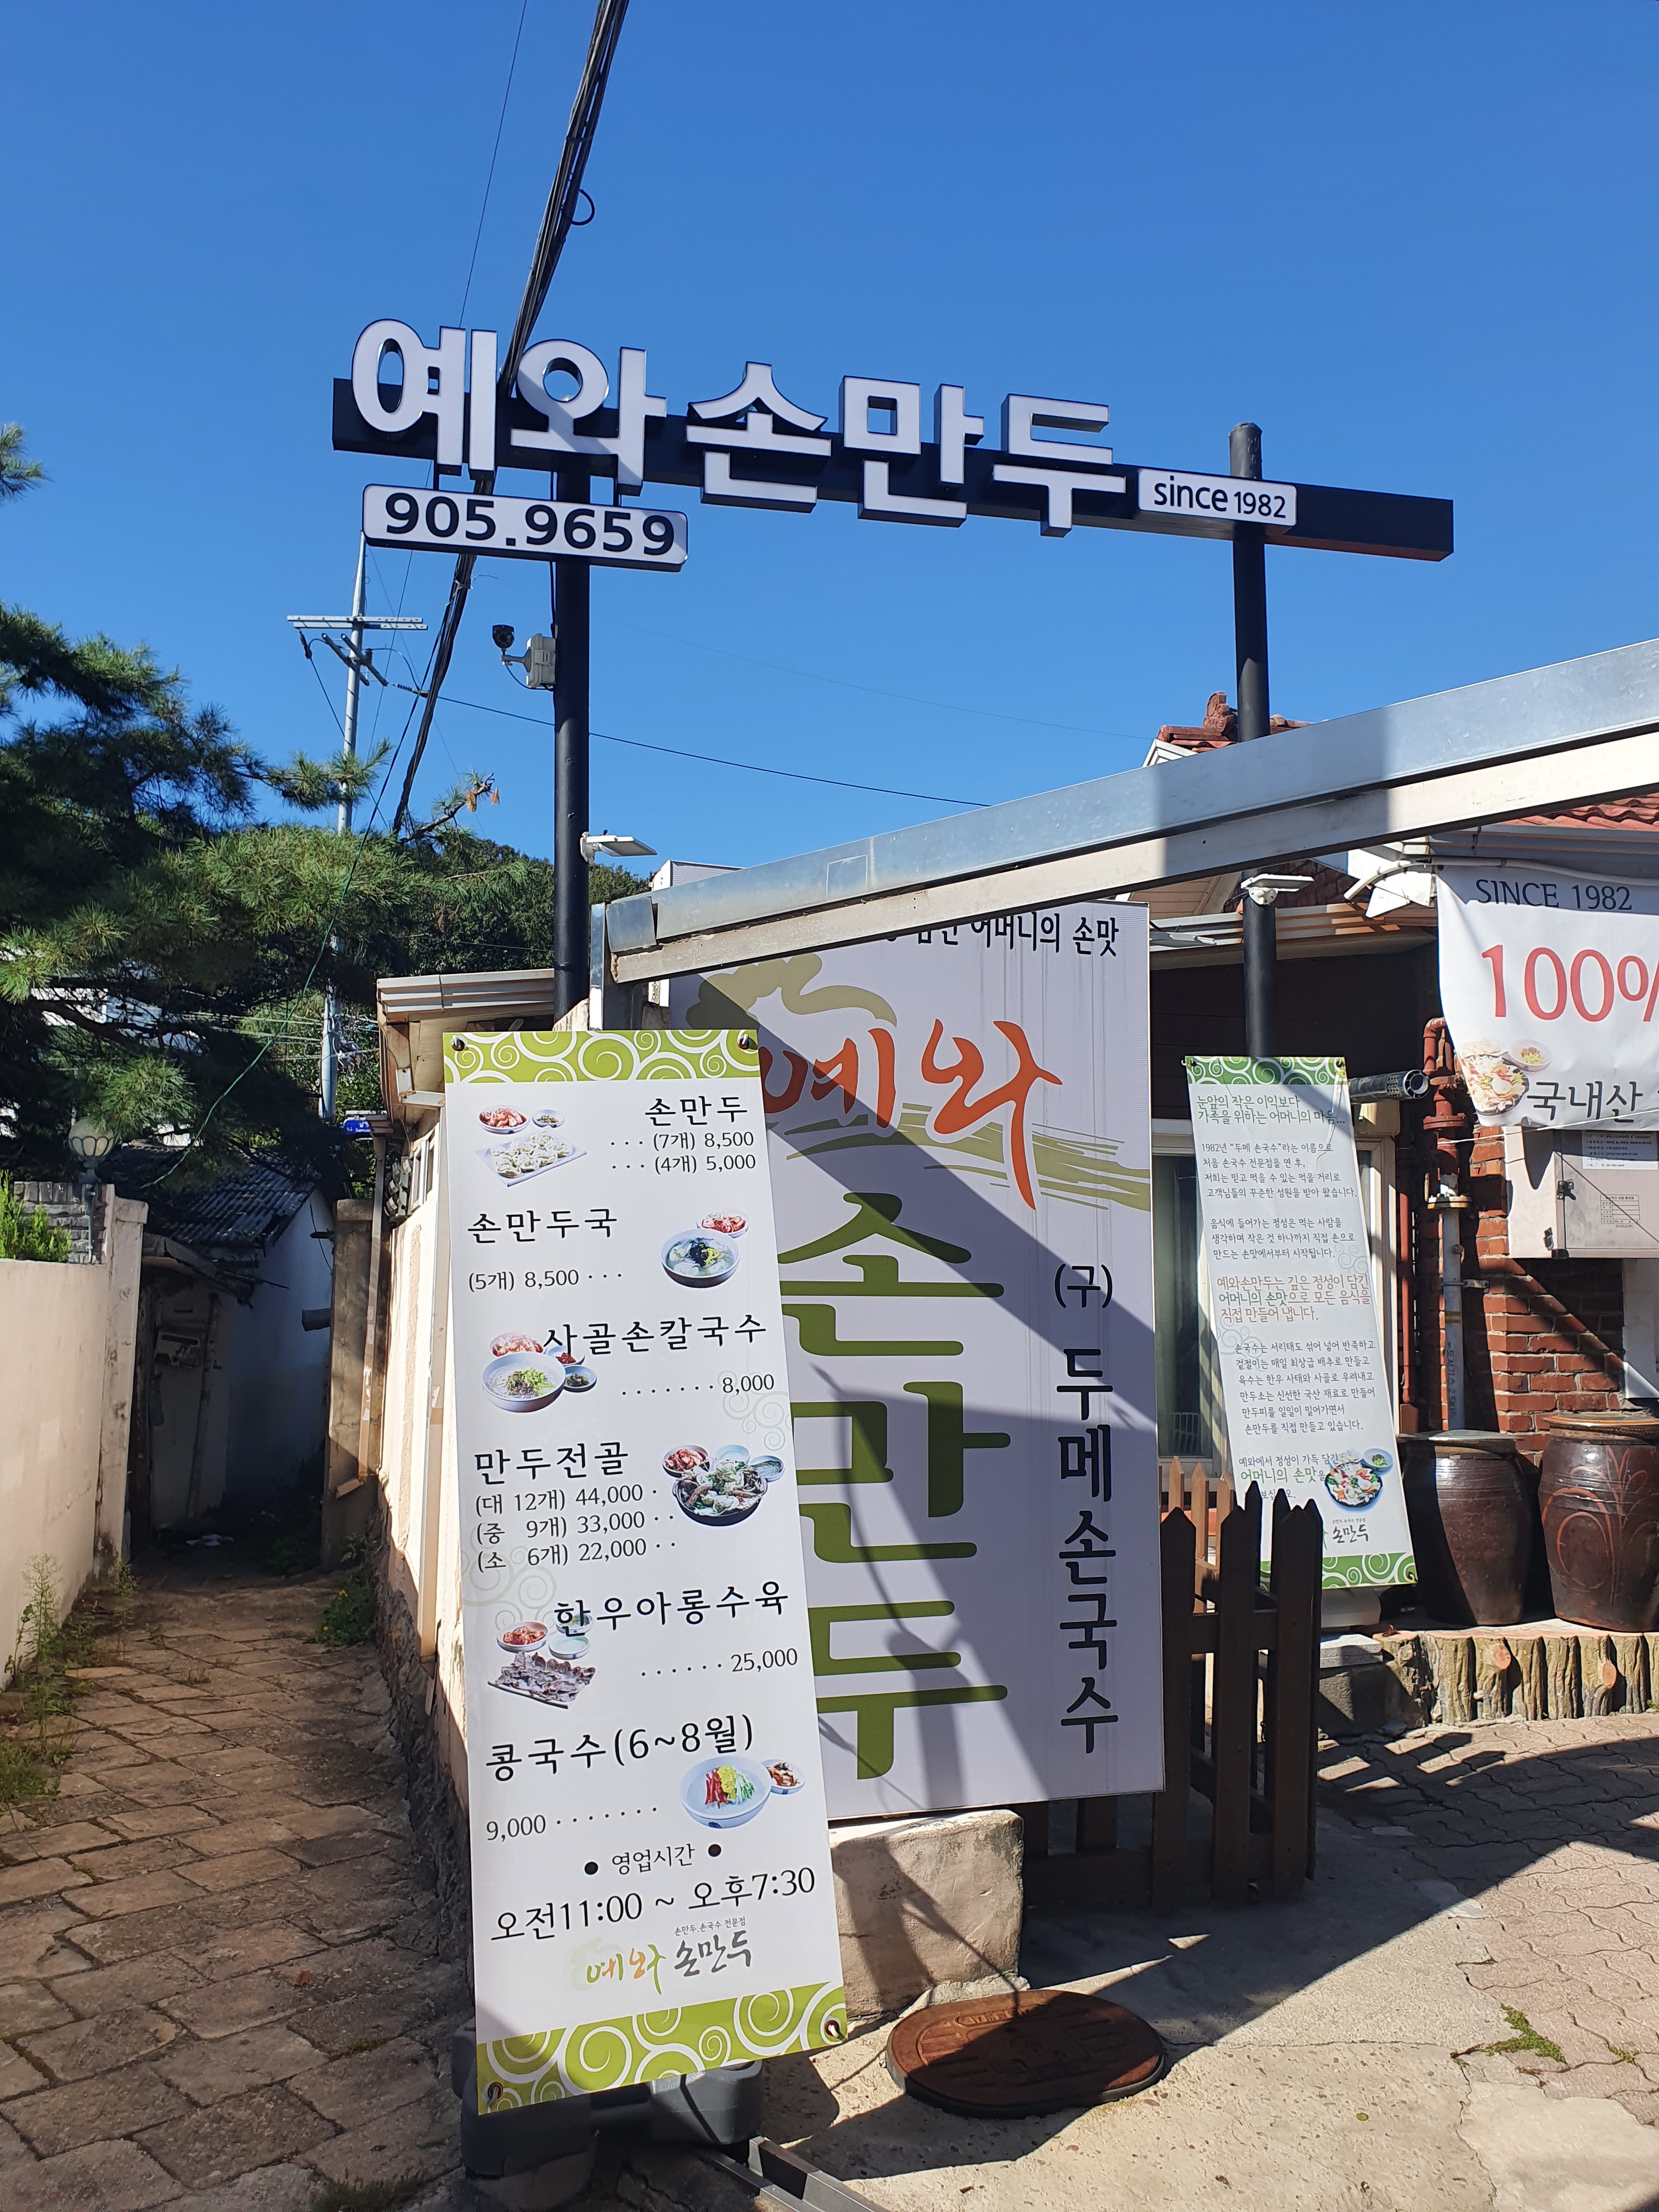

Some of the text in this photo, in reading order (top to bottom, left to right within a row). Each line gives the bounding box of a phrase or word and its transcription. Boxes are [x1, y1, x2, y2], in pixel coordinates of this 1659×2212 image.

[1154, 476, 1286, 518] since 1982
[382, 487, 678, 560] 905.9659
[1476, 879, 1633, 910] SINCE 1982
[1073, 916, 1119, 957] 손맛
[645, 1096, 747, 1126] 손만두
[1197, 1093, 1300, 1111] 눈앞의 작은 이익보다
[1527, 1081, 1643, 1122] 국내산
[759, 1019, 1062, 1210] 예와
[1198, 1110, 1232, 1124] 가족을
[1234, 1110, 1267, 1124] 위하는
[1269, 1108, 1311, 1124] 어머니의
[654, 1132, 753, 1151] (7개) 8,500
[1202, 1143, 1227, 1153] 1982년
[1301, 1143, 1334, 1154] 이름으로
[656, 1155, 755, 1175] (4개) 5,000
[1203, 1158, 1305, 1168] 처음 손국수 전문점을 연 후,
[1205, 1172, 1341, 1183] 저희는 믿고 먹을 수 있는 먹을 거리로
[1207, 1186, 1358, 1198] 고객님들의 꾸준한 성원을 받아 왔습니다.
[468, 1209, 617, 1243] 손만두국
[1210, 1217, 1342, 1229] 음식에 들어가는 정성은 먹는 사람을
[1212, 1233, 1356, 1244] 생각하며 작은 것 하나까지 직접 손으로
[1214, 1248, 1335, 1260] 만드는 손맛에서부터 시작됩니다.
[469, 1269, 579, 1293] (5개) 8,500
[1054, 1264, 1113, 1308] (구)
[1217, 1274, 1369, 1291] 예와손만두는 깊은 정성이 담긴
[1219, 1290, 1371, 1306] 어머니의 손맛으로 모든 음식을
[1220, 1306, 1318, 1324] 직접 만들어 냅니다.
[543, 1314, 766, 1355] 사골손칼국수
[1234, 1340, 1375, 1354] 손국수는 서리태도 섞어 넣어 반죽하고
[1236, 1356, 1370, 1369] 겉절이는 매일 최상급 배추로 만들고
[723, 1374, 774, 1395] 8,000
[1238, 1372, 1374, 1386] 육수는 한우 사태와 사골로 우려내고
[1240, 1387, 1375, 1402] 만두소는 신선한 국산 재료로 만들어
[1242, 1404, 1344, 1418] 만두피를 일일이 밀어가면서
[1245, 1419, 1363, 1435] 손만두를 직접 만들고 있습니다.
[475, 1442, 628, 1485] 만두전골
[1239, 1453, 1339, 1467] 예와에서 정성이 가득 담긴
[1240, 1466, 1288, 1483] 어머니의
[778, 1192, 1011, 1780] 손만두
[476, 1485, 642, 1517] (대 12개) 44,000
[477, 1511, 645, 1545] (중 9개) 33,000
[1333, 1524, 1368, 1543] 손만두
[478, 1538, 646, 1573] (소 6개) 22,000
[554, 1582, 788, 1637] 한우아롱수육
[731, 1648, 797, 1672] 25,000
[487, 1815, 545, 1842] 9,000
[612, 1843, 695, 1875] 영업시간
[491, 1867, 814, 1940] 오전11:00 ~ 오후7:30
[725, 1916, 745, 1928] 전문점
[674, 1930, 751, 1977] 손만두
